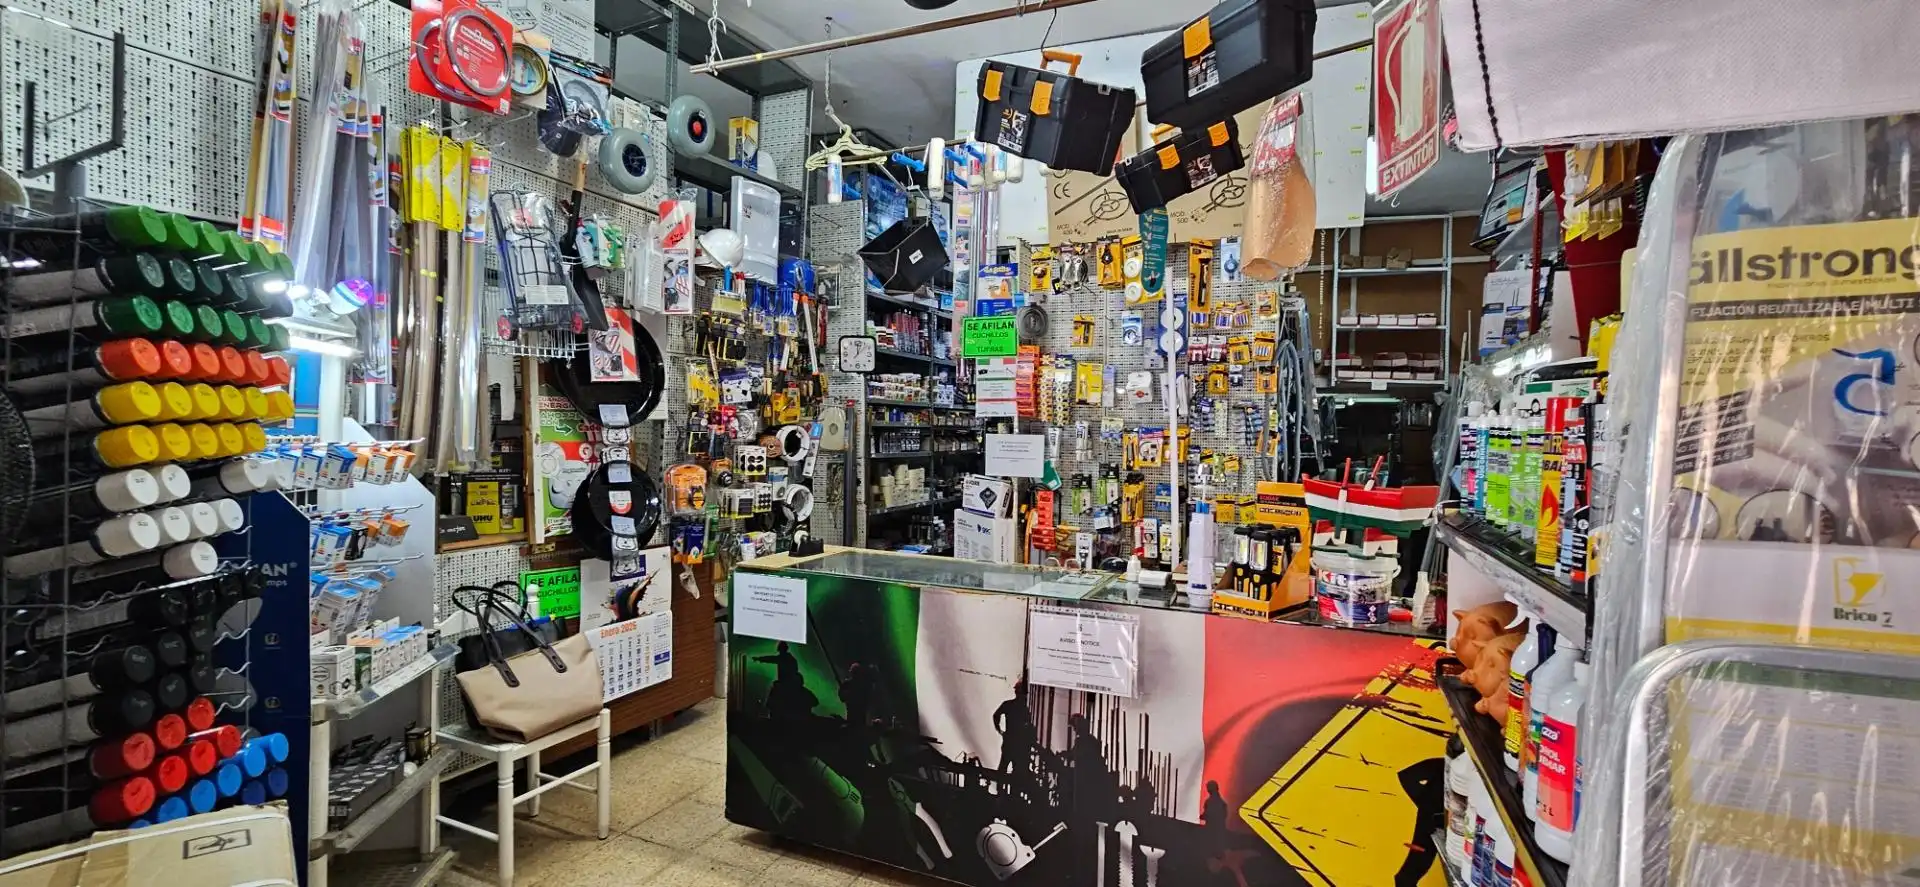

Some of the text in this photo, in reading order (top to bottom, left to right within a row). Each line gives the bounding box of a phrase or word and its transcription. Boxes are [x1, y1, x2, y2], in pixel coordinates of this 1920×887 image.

[1383, 138, 1434, 188] EXTINTOR
[1691, 303, 1755, 318] FIJACIÓN
[1758, 300, 1859, 315] REUTILIZABLE
[968, 321, 1015, 331] SE AFILAN
[473, 514, 493, 522] UHU
[530, 573, 579, 588] SE AFILA
[1318, 568, 1348, 587] Kit
[1833, 607, 1895, 625] Brico 7
[600, 627, 620, 638] Enero
